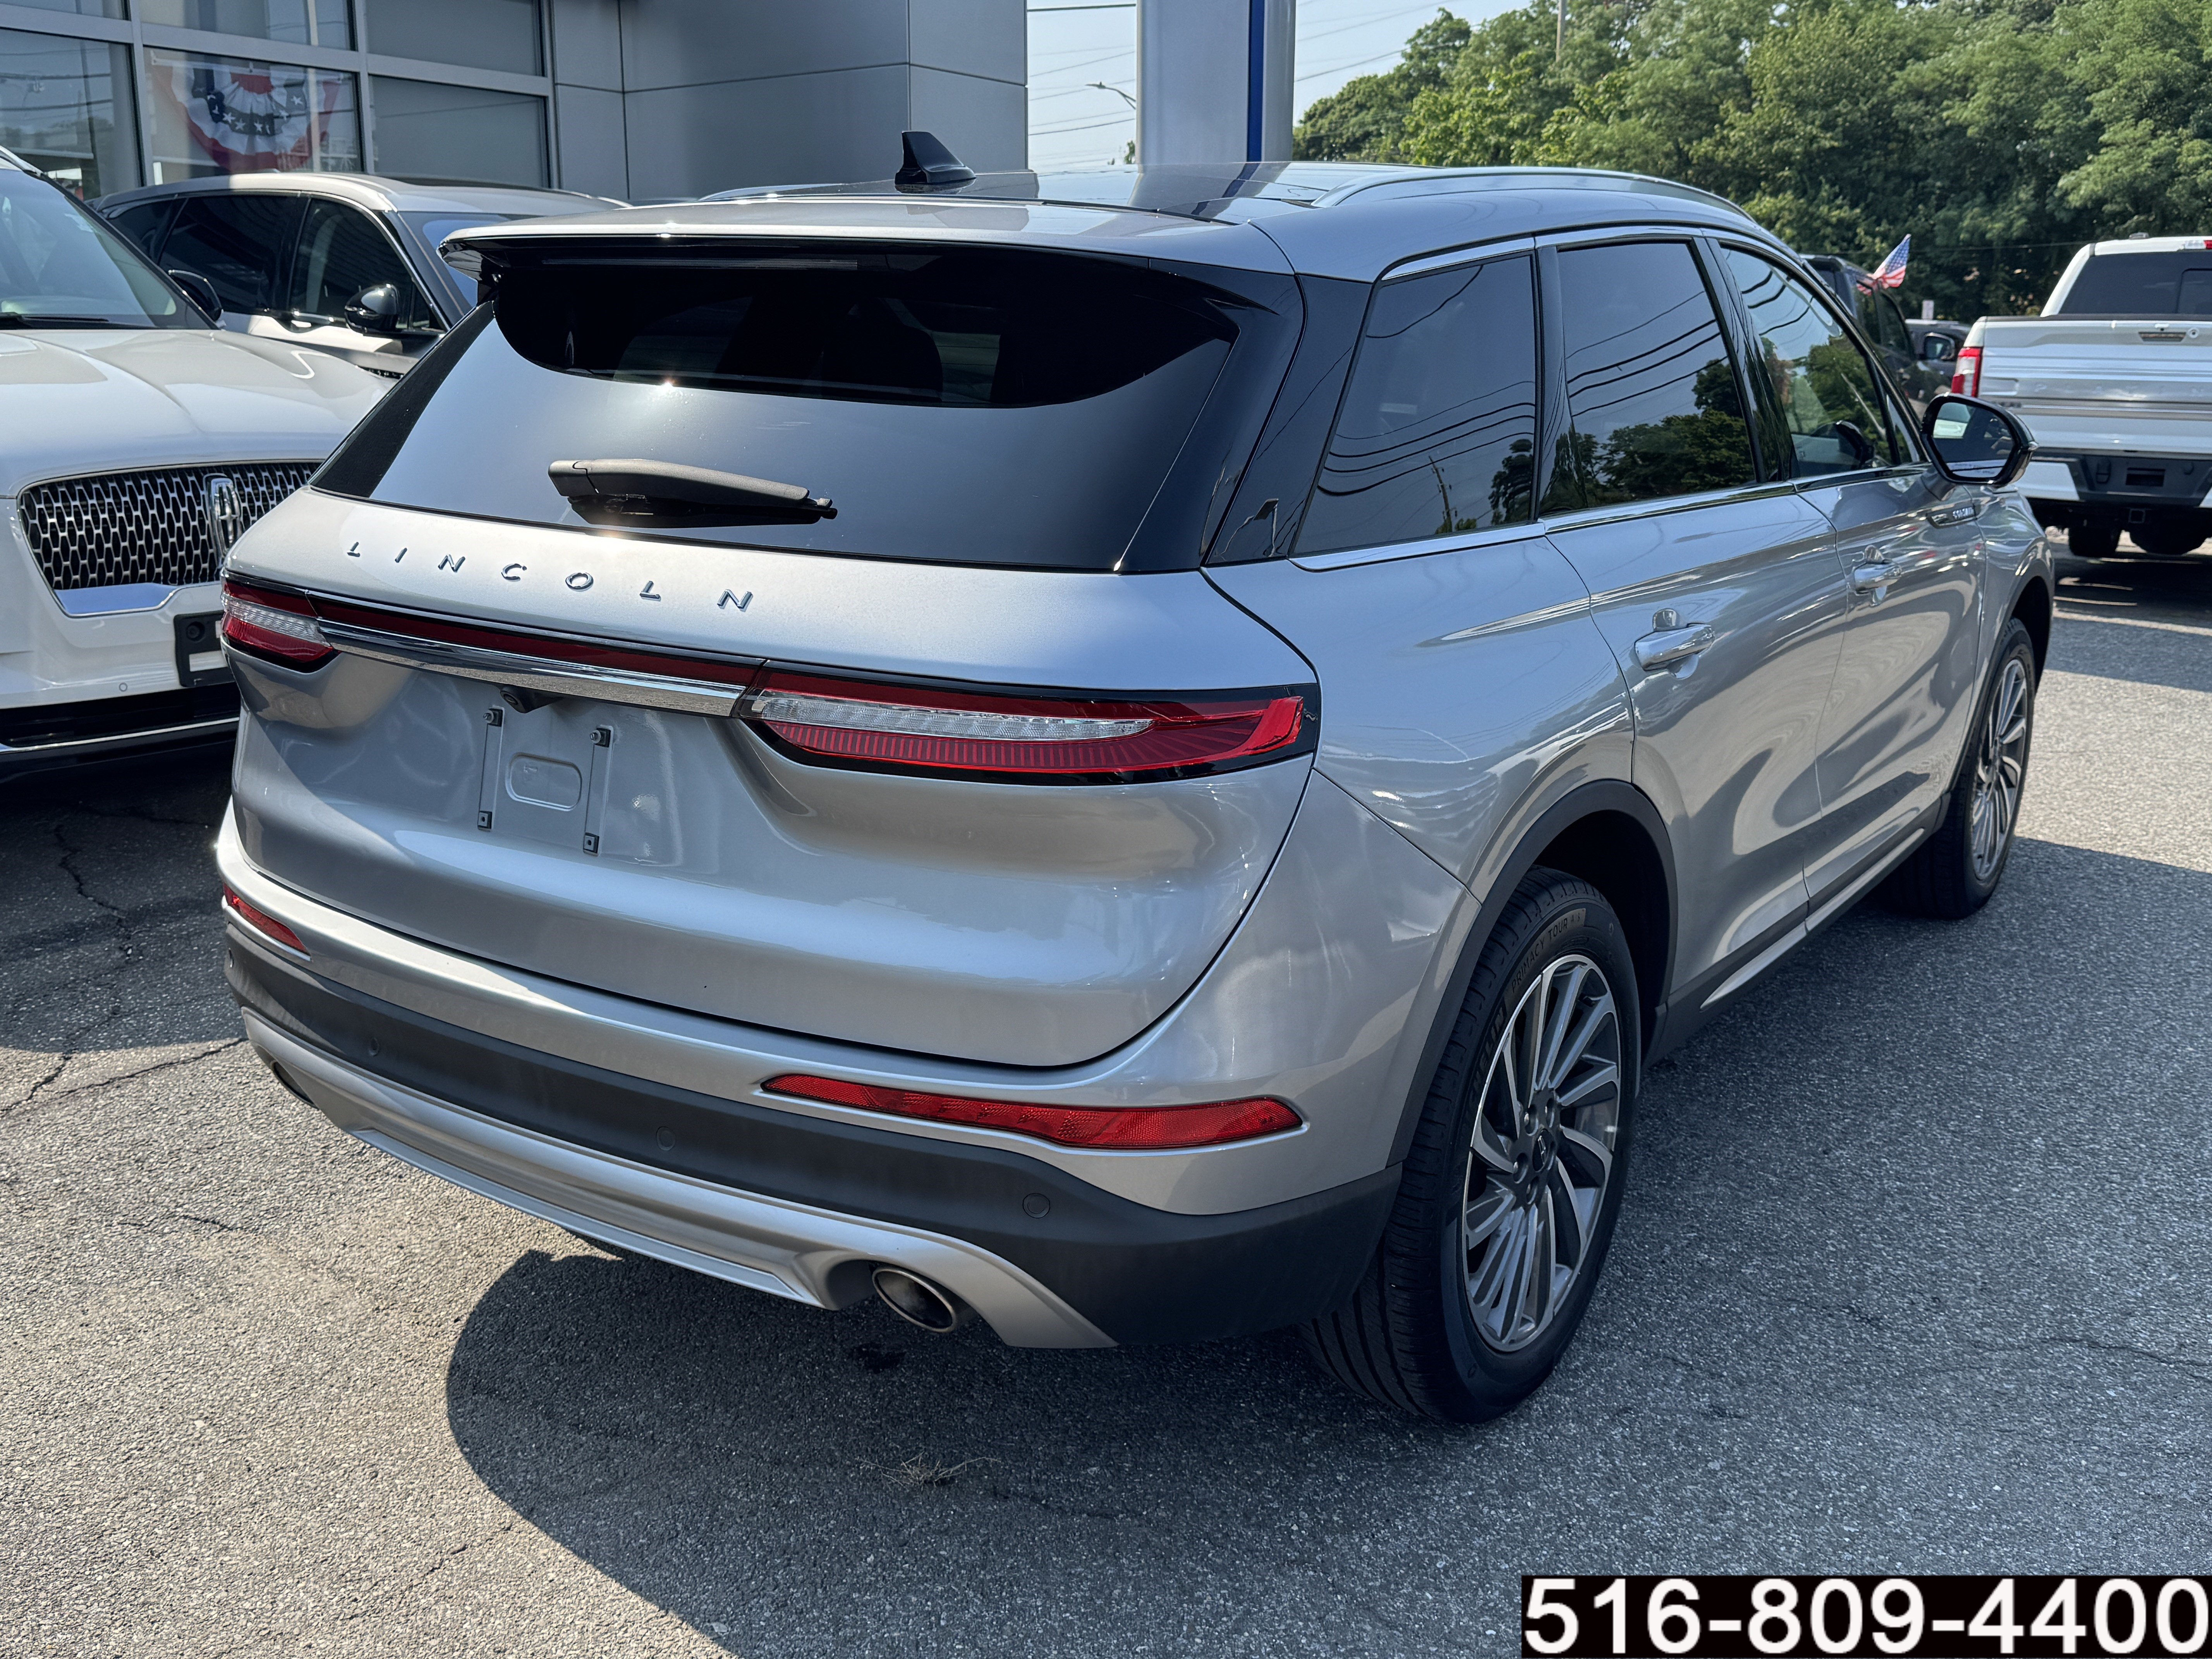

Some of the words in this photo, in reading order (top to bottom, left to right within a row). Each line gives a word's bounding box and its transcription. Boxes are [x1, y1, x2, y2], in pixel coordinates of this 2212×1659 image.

[346, 541, 754, 612] LINCOLN
[1511, 936, 1545, 993] PRIMACY
[1548, 918, 1568, 940] TOUR
